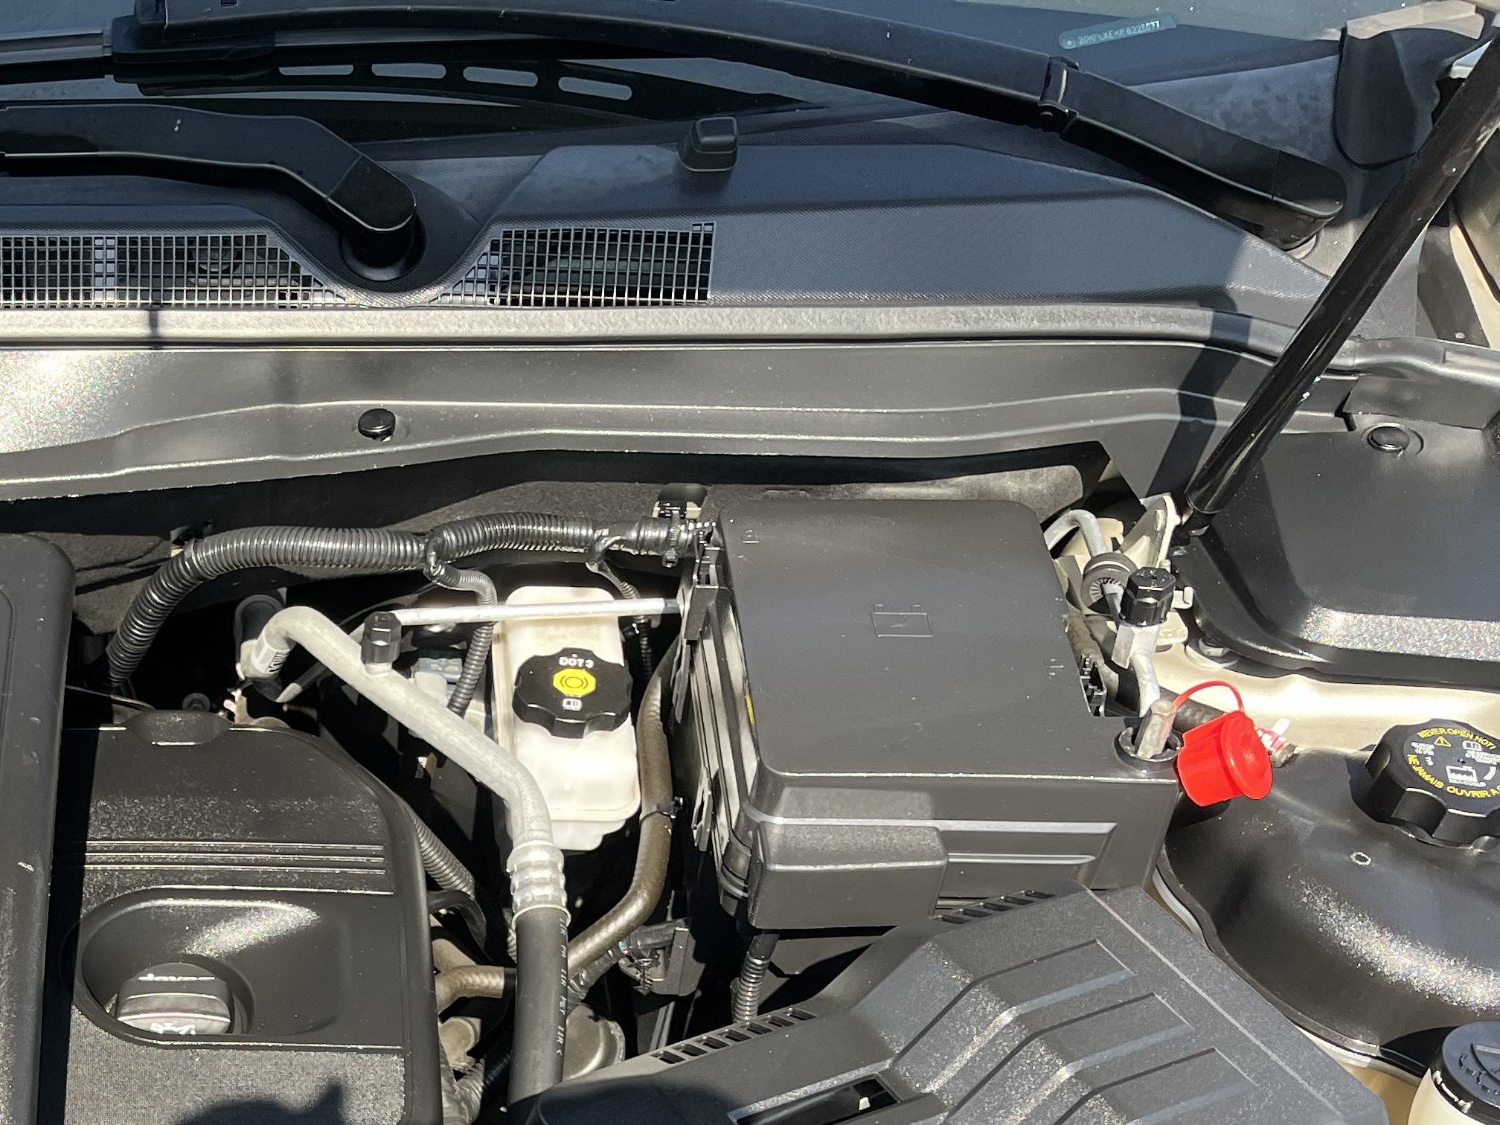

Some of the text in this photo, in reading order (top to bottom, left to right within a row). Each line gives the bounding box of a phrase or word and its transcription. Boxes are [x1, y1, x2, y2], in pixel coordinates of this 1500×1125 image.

[558, 656, 594, 668] DOT 3
[1417, 728, 1496, 750] NEVER OPEN HOT!
[1412, 766, 1444, 788] JAMAIS
[1446, 786, 1491, 798] OUVRIR
